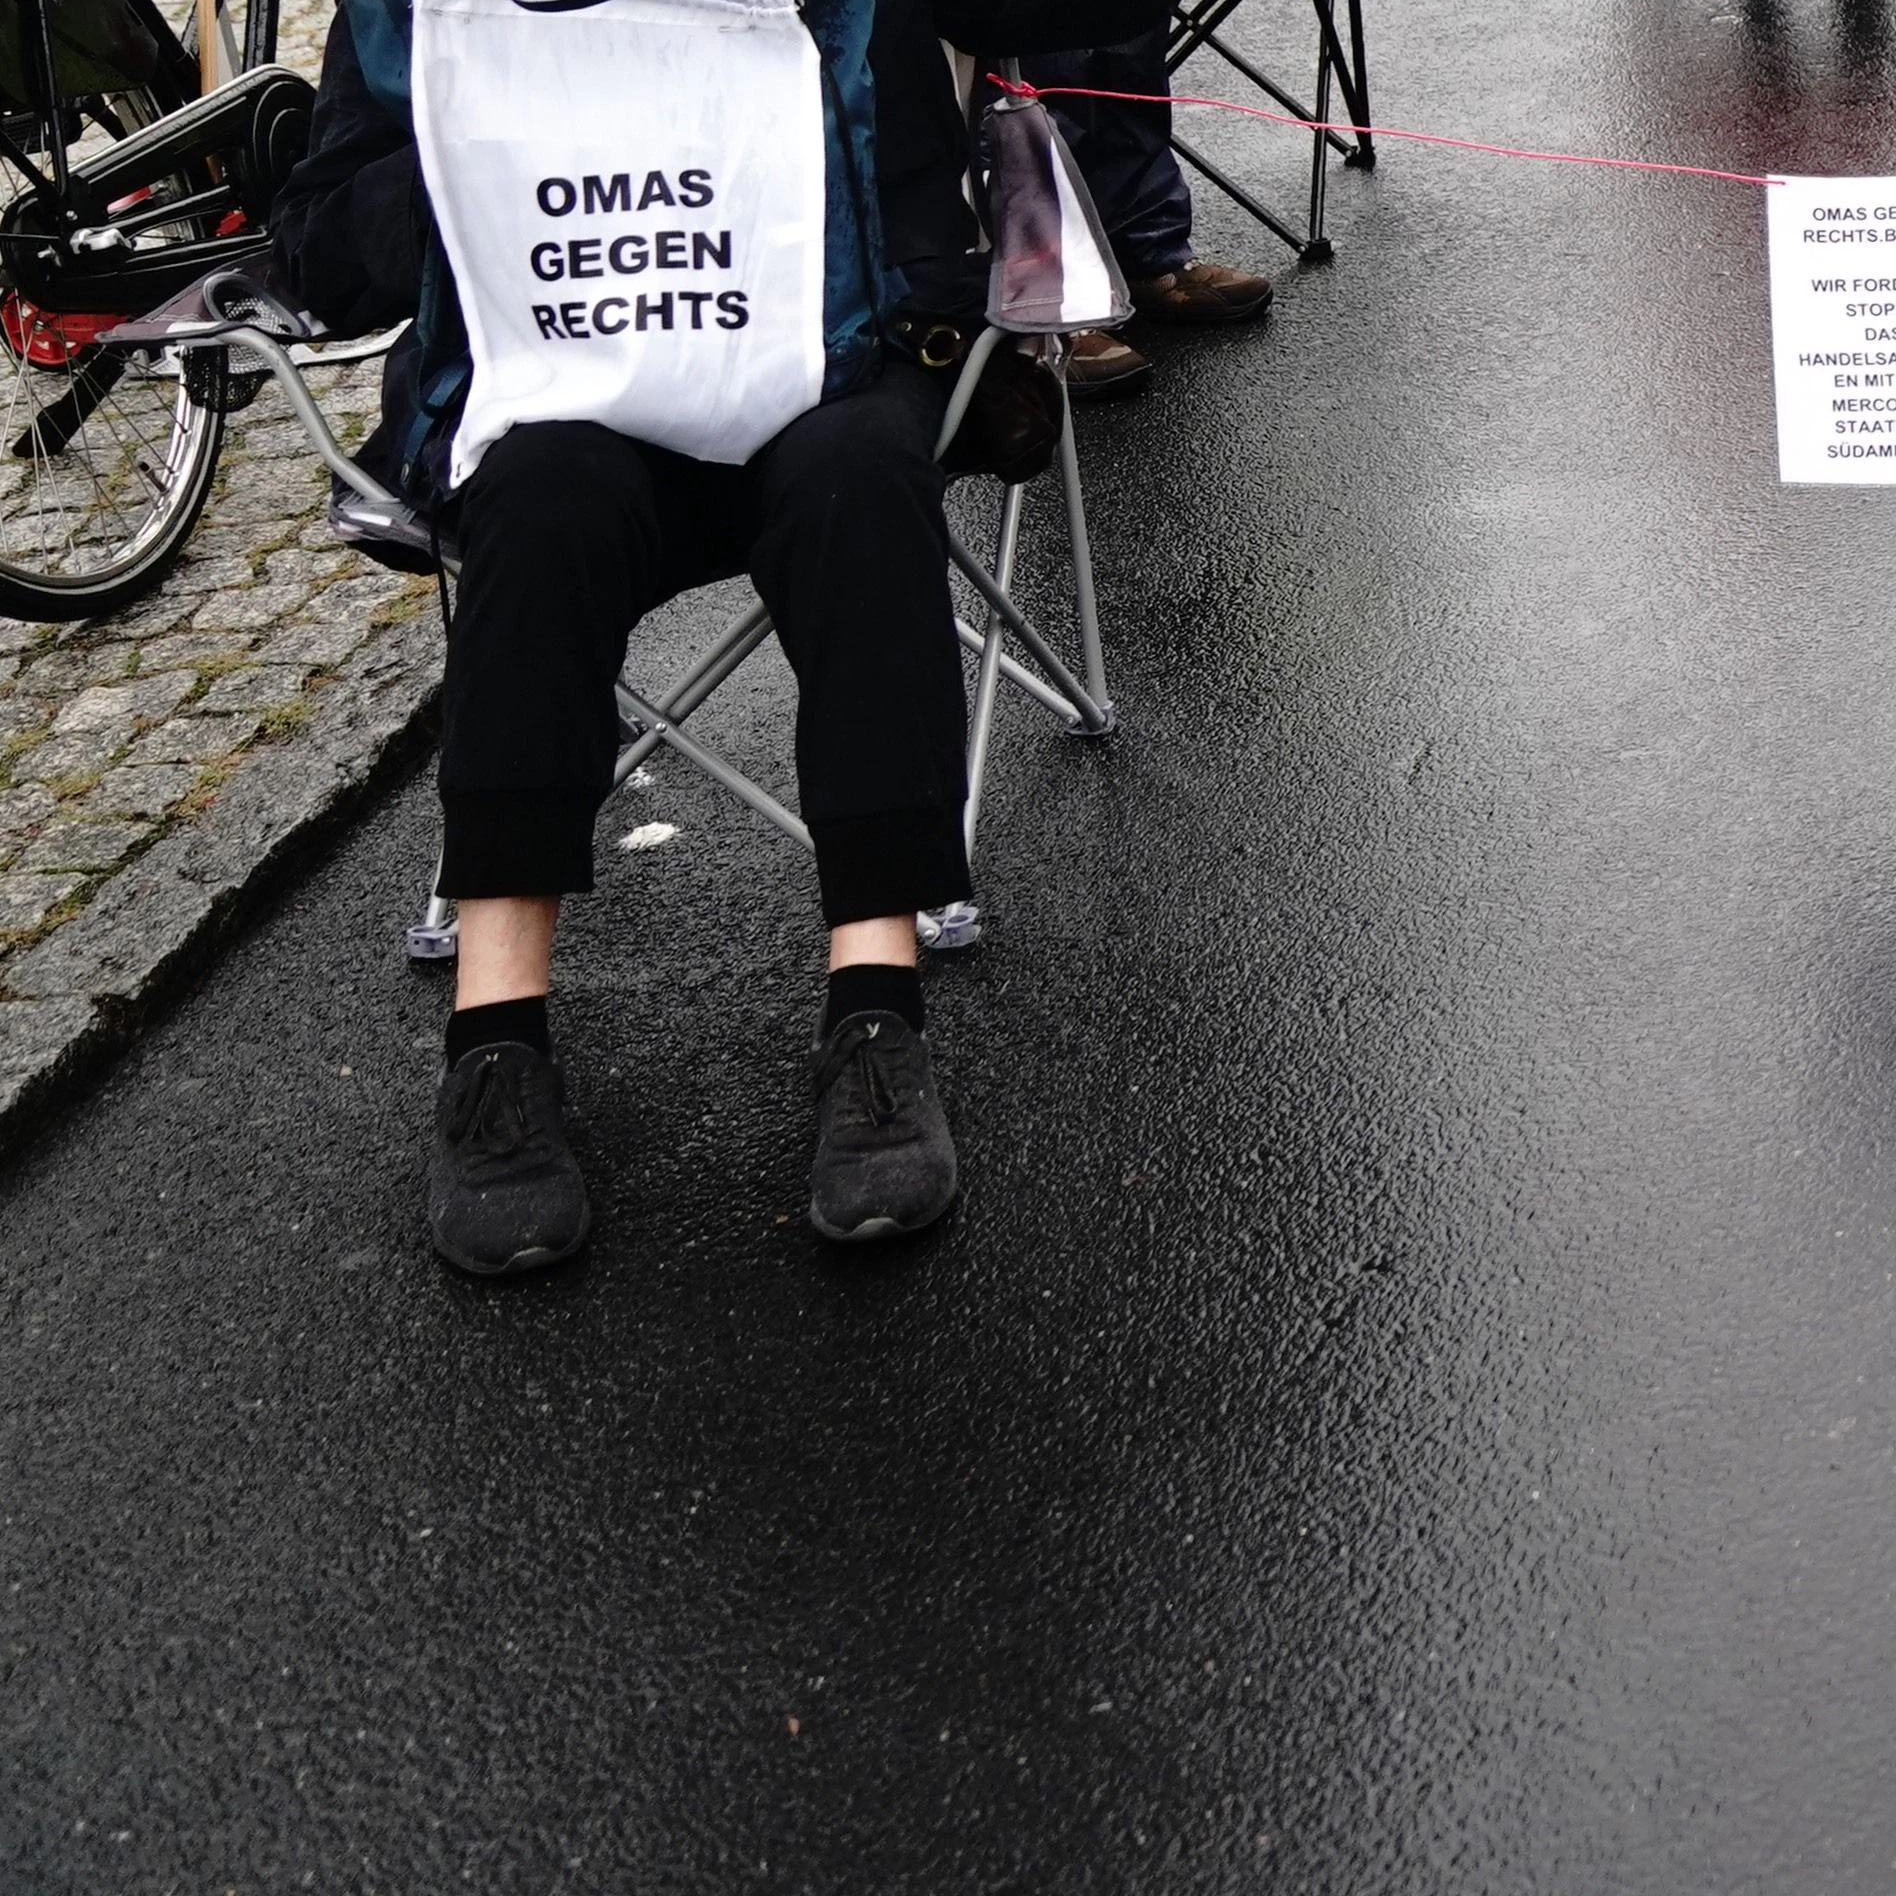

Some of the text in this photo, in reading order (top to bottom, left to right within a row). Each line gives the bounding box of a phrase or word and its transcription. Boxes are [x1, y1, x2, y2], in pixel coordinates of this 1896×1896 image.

[536, 169, 714, 217] OMAS
[1812, 208, 1867, 222] OMAS
[530, 230, 732, 281] GEGEN
[1812, 279, 1846, 292] WIR
[531, 290, 750, 340] RECHTS
[1834, 374, 1858, 388] EN
[1865, 374, 1894, 387] MIT
